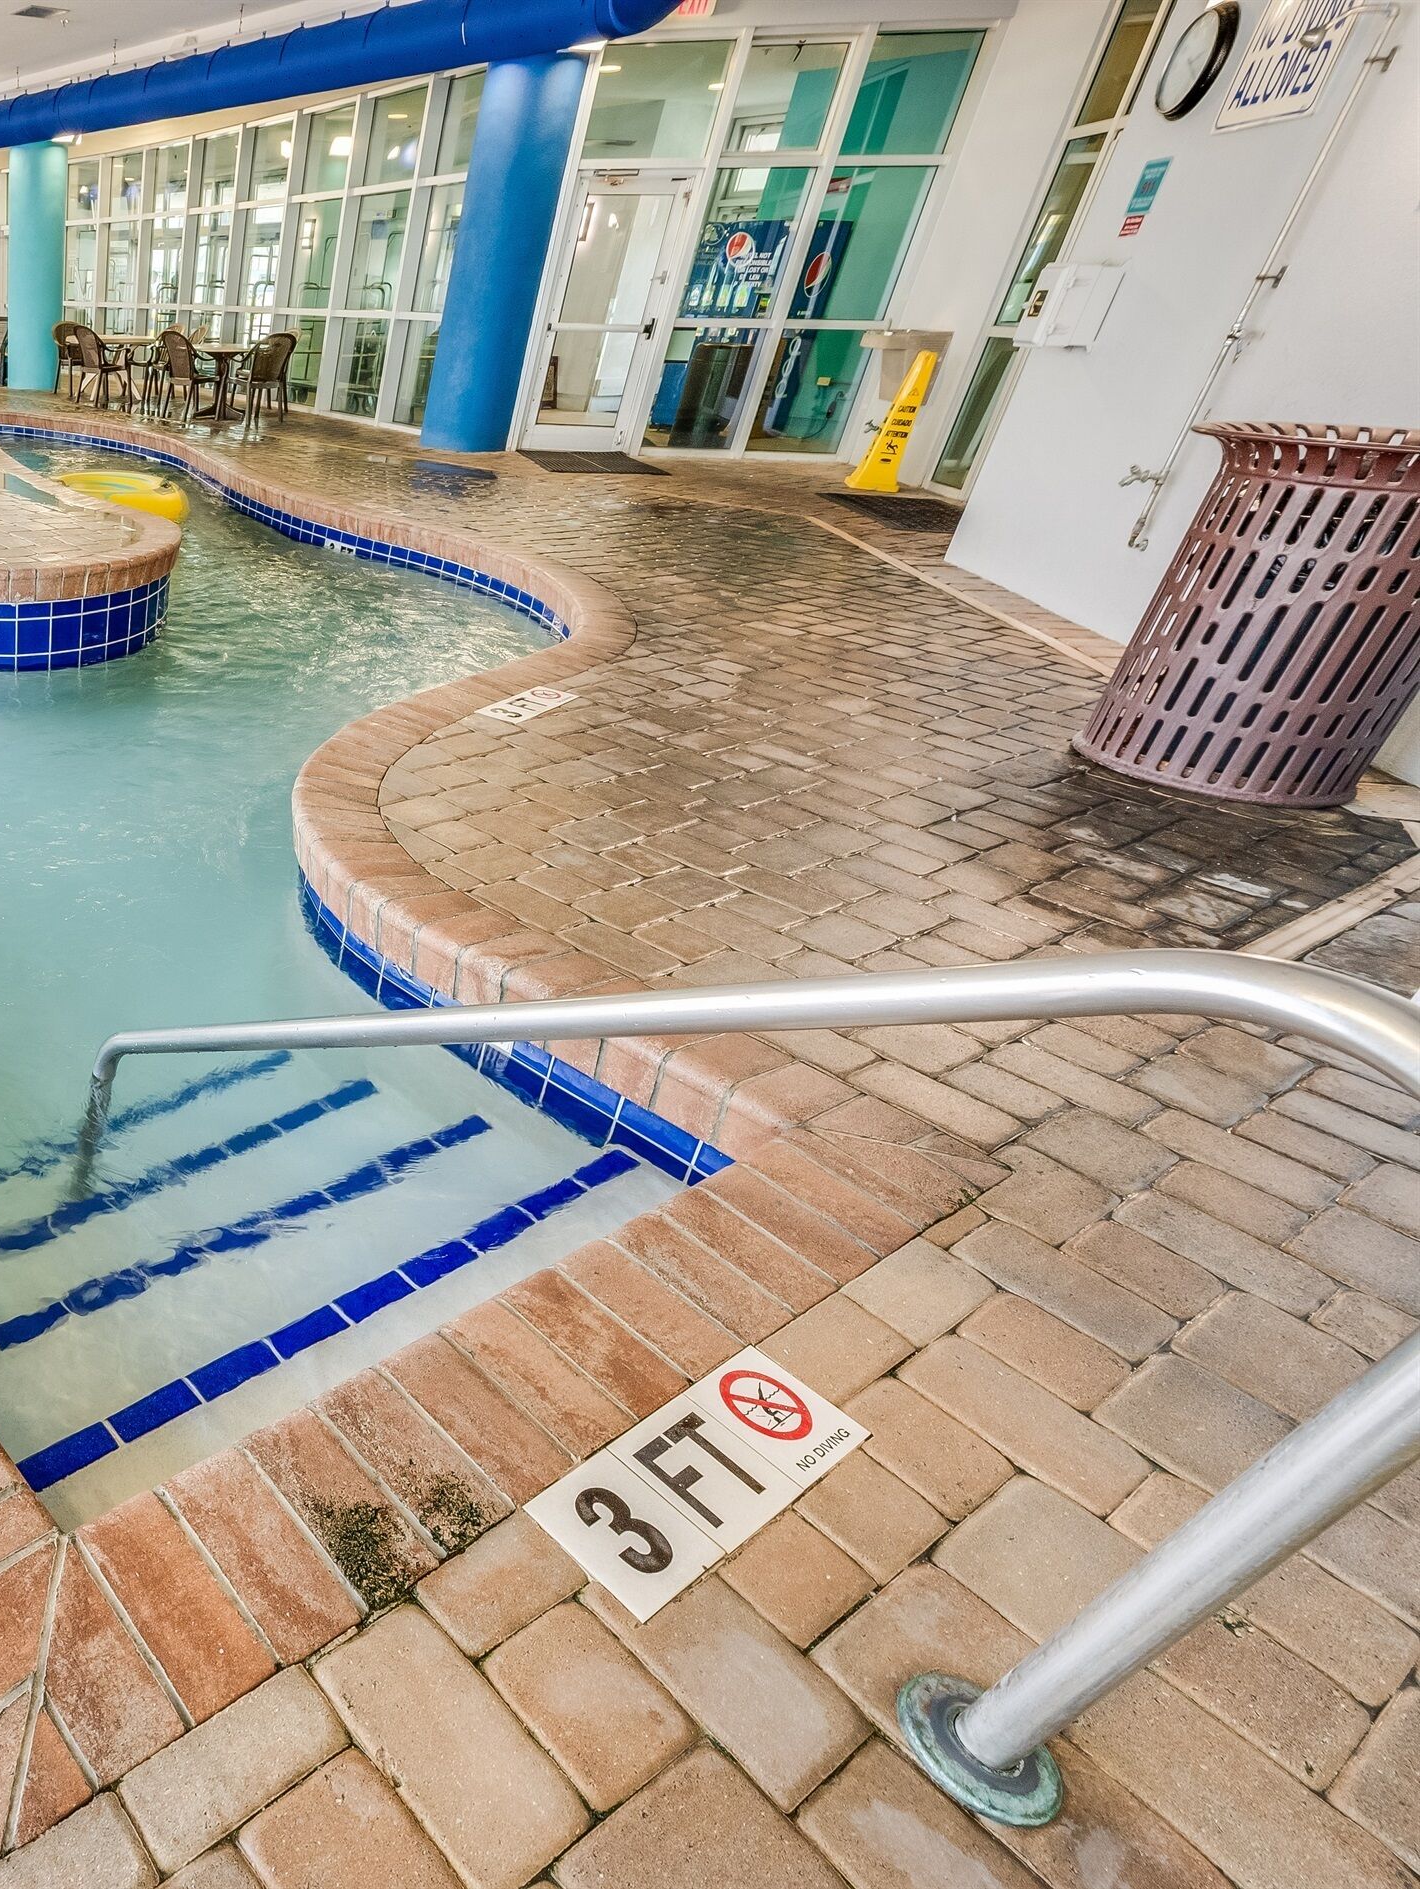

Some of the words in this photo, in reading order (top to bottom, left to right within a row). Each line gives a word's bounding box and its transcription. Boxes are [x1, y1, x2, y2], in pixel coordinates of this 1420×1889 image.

[1228, 40, 1331, 111] ALLOWED
[490, 707, 523, 719] 3
[506, 696, 548, 712] FT
[795, 1454, 817, 1472] NO
[812, 1428, 851, 1458] DIVING
[574, 1487, 674, 1574] 3
[632, 1411, 767, 1530] FT
